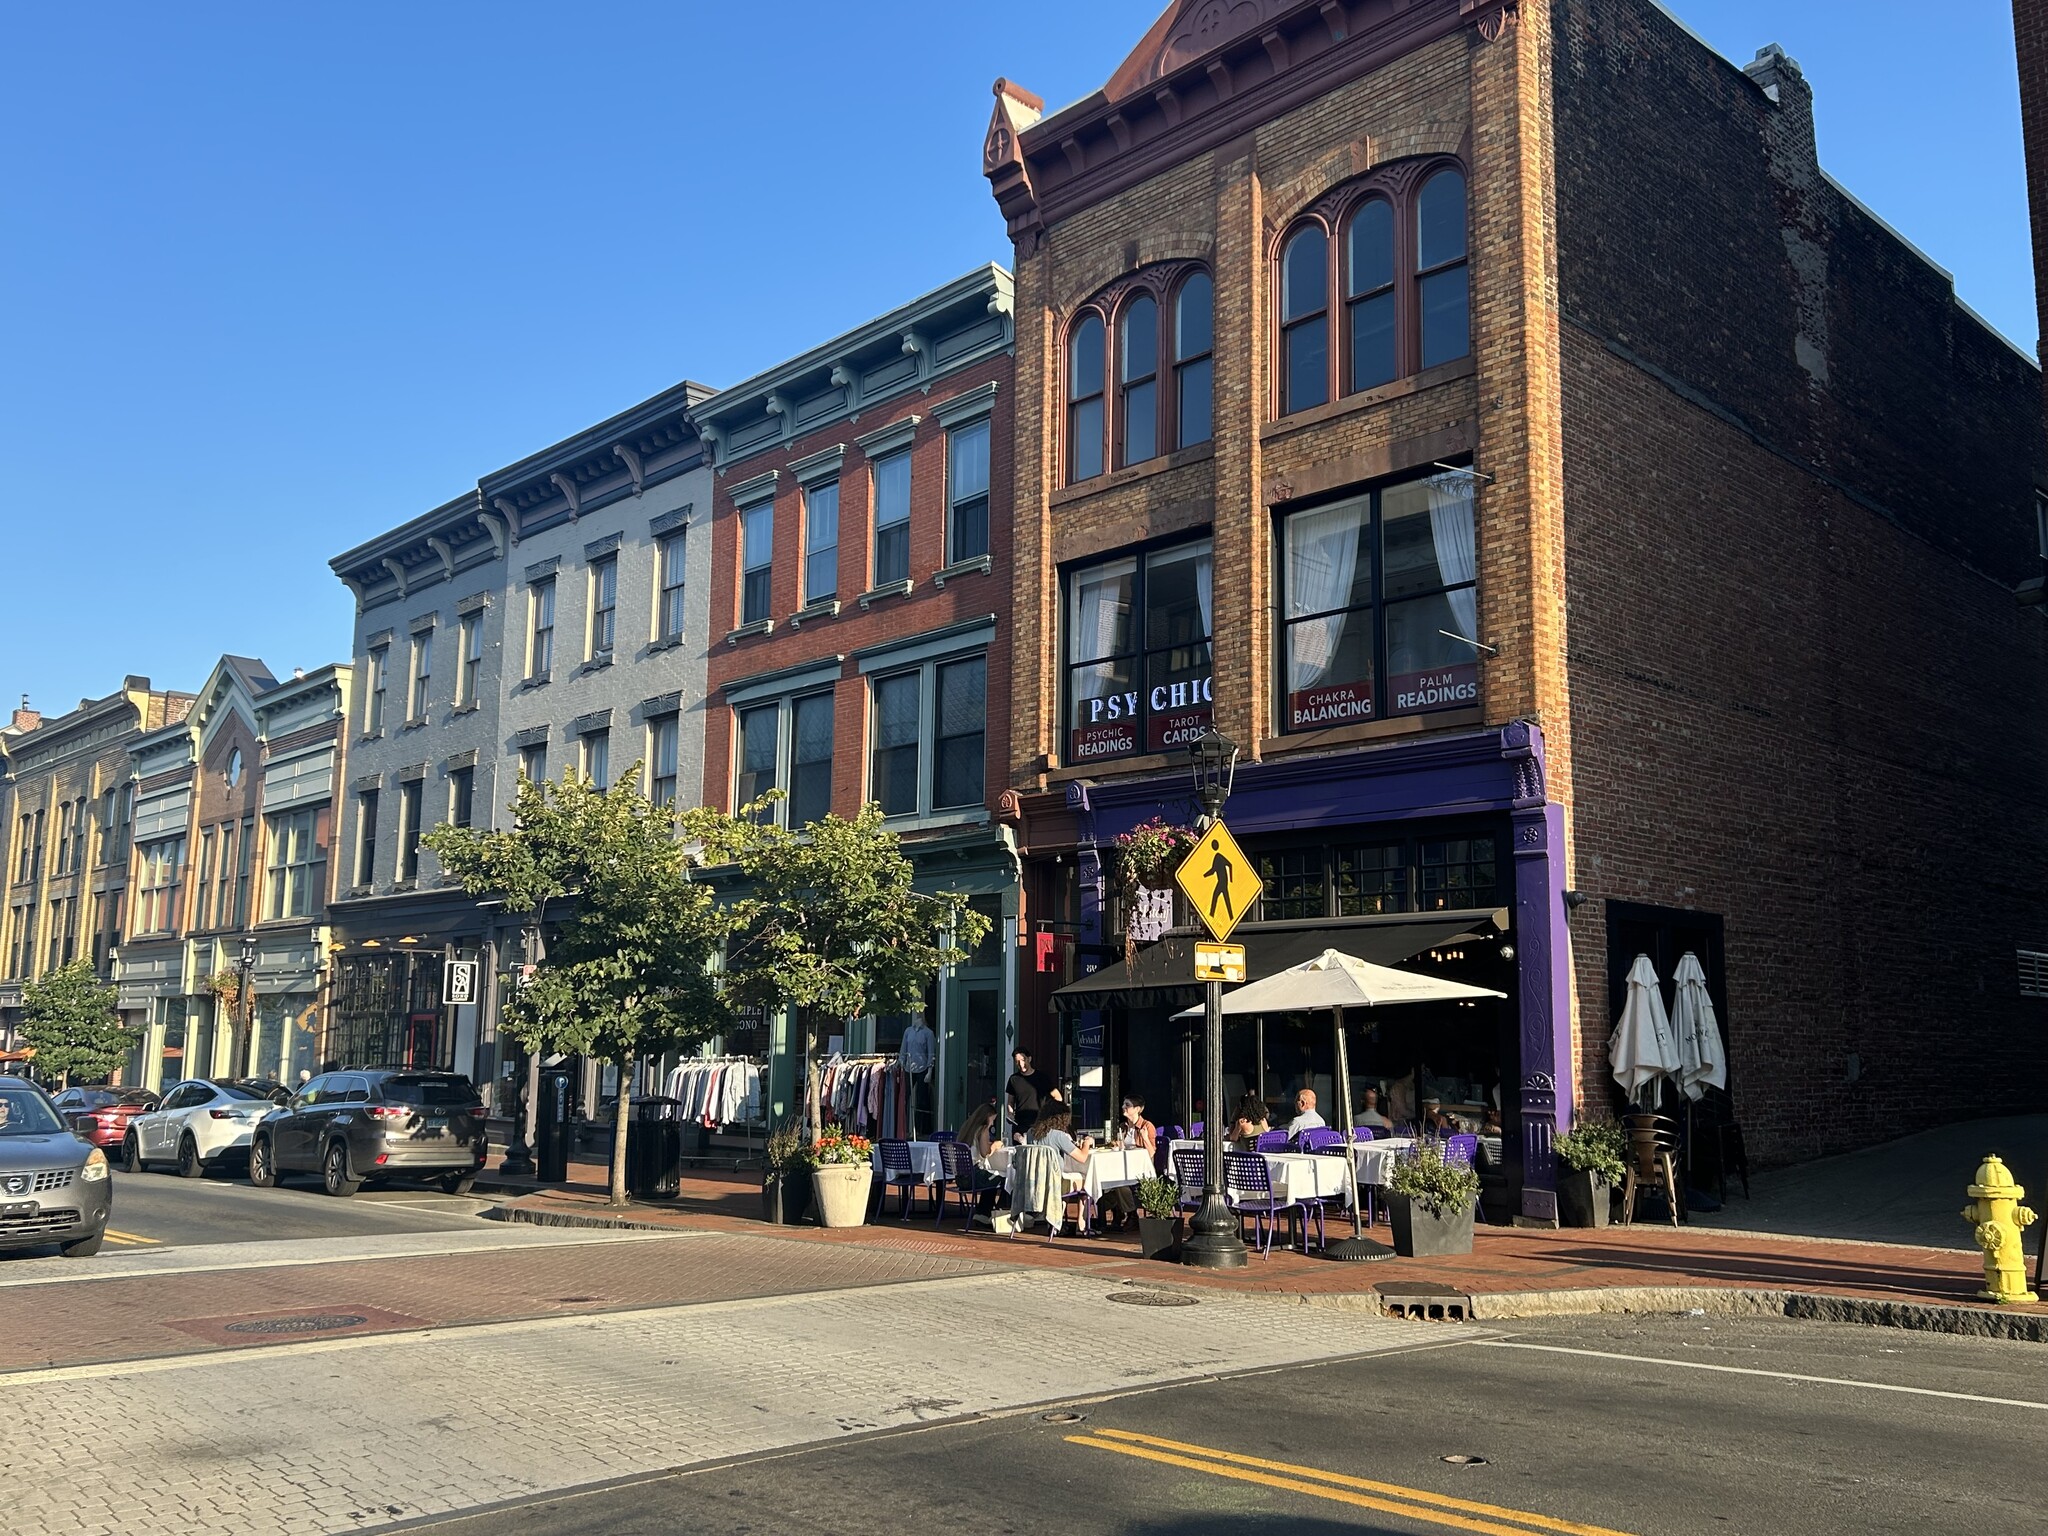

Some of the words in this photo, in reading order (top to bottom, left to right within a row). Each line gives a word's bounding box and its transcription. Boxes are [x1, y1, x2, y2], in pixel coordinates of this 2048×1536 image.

[1419, 673, 1453, 689] PALM
[1308, 689, 1355, 706] CHAKRA
[1397, 682, 1476, 709] READINGS
[1293, 698, 1371, 724] BALANCING
[1169, 715, 1200, 728] TAROT
[1086, 727, 1124, 741] PSYCHIC
[1163, 726, 1206, 745] CARDS
[1078, 736, 1133, 757] READINGS
